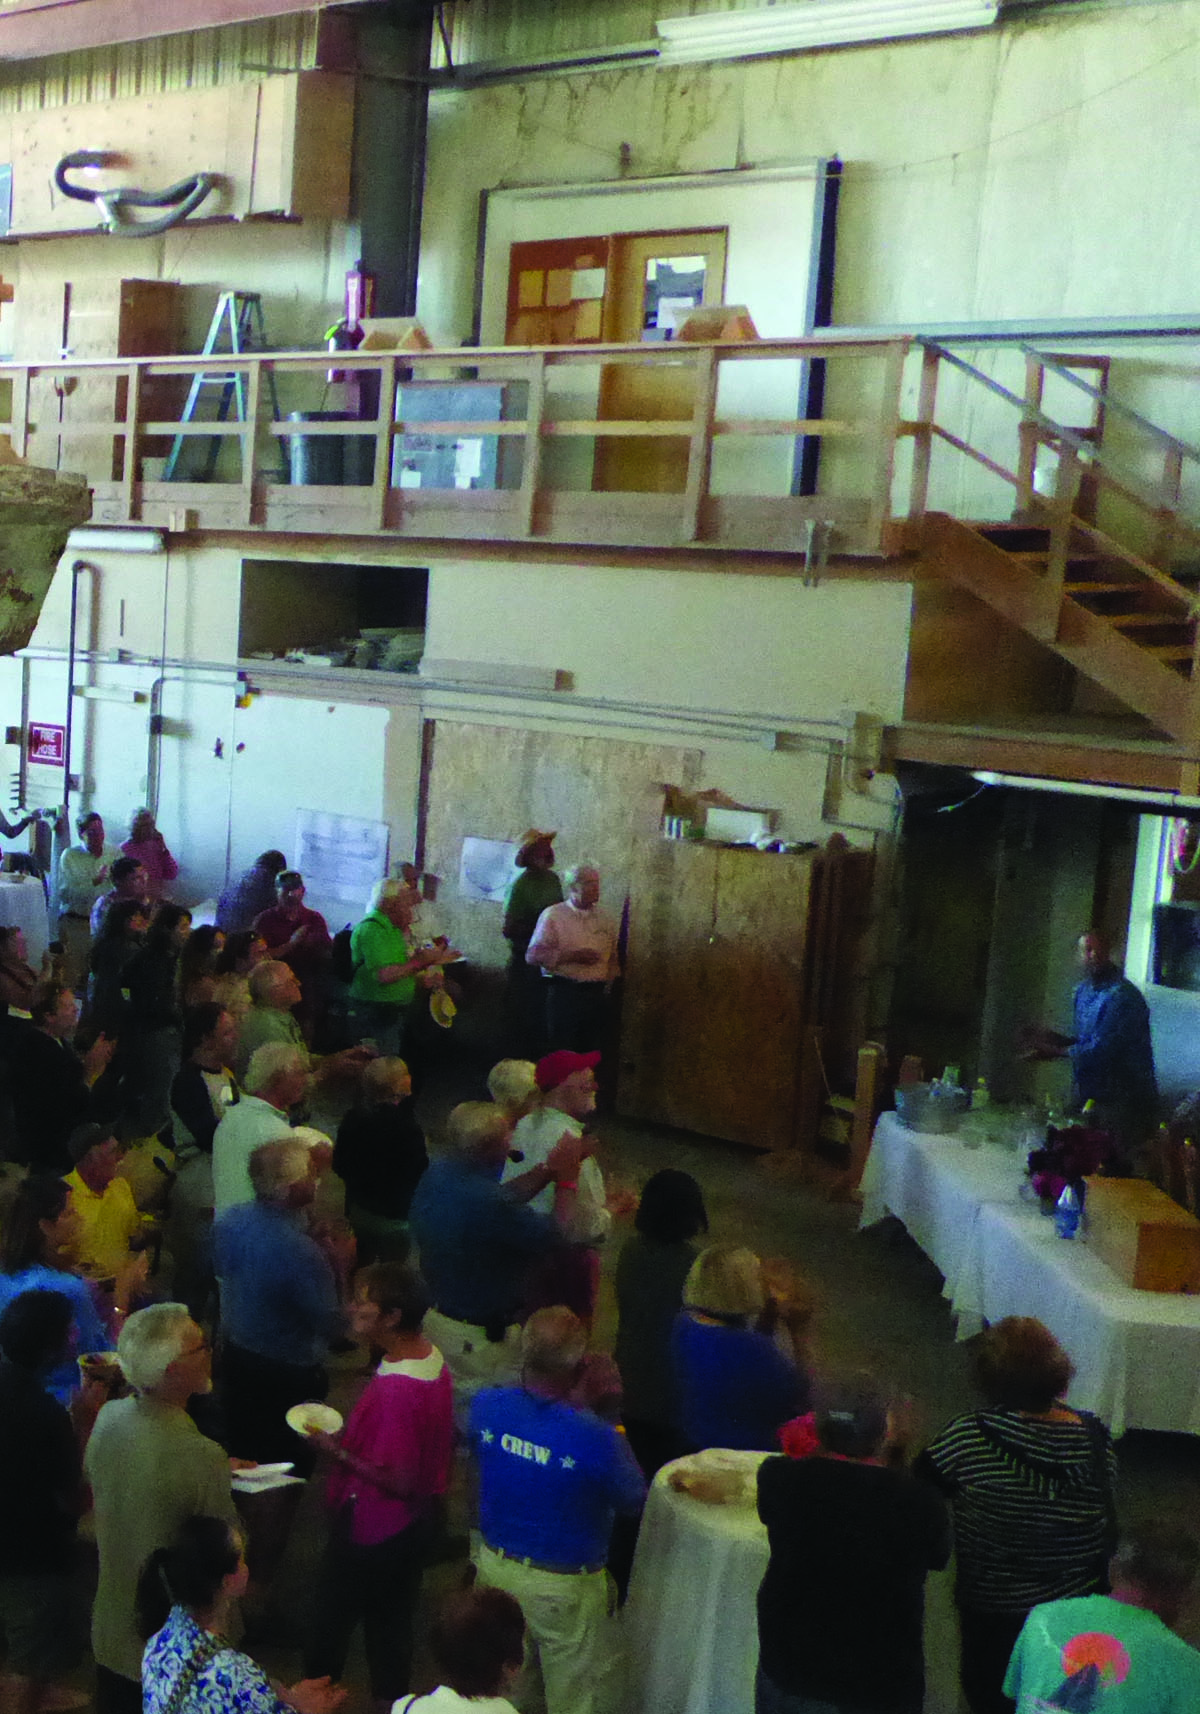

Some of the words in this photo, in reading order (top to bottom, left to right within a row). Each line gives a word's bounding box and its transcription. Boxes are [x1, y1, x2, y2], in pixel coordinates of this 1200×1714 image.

[40, 730, 56, 743] FIRE
[37, 744, 57, 757] HOSE
[500, 1433, 551, 1465] CREW
